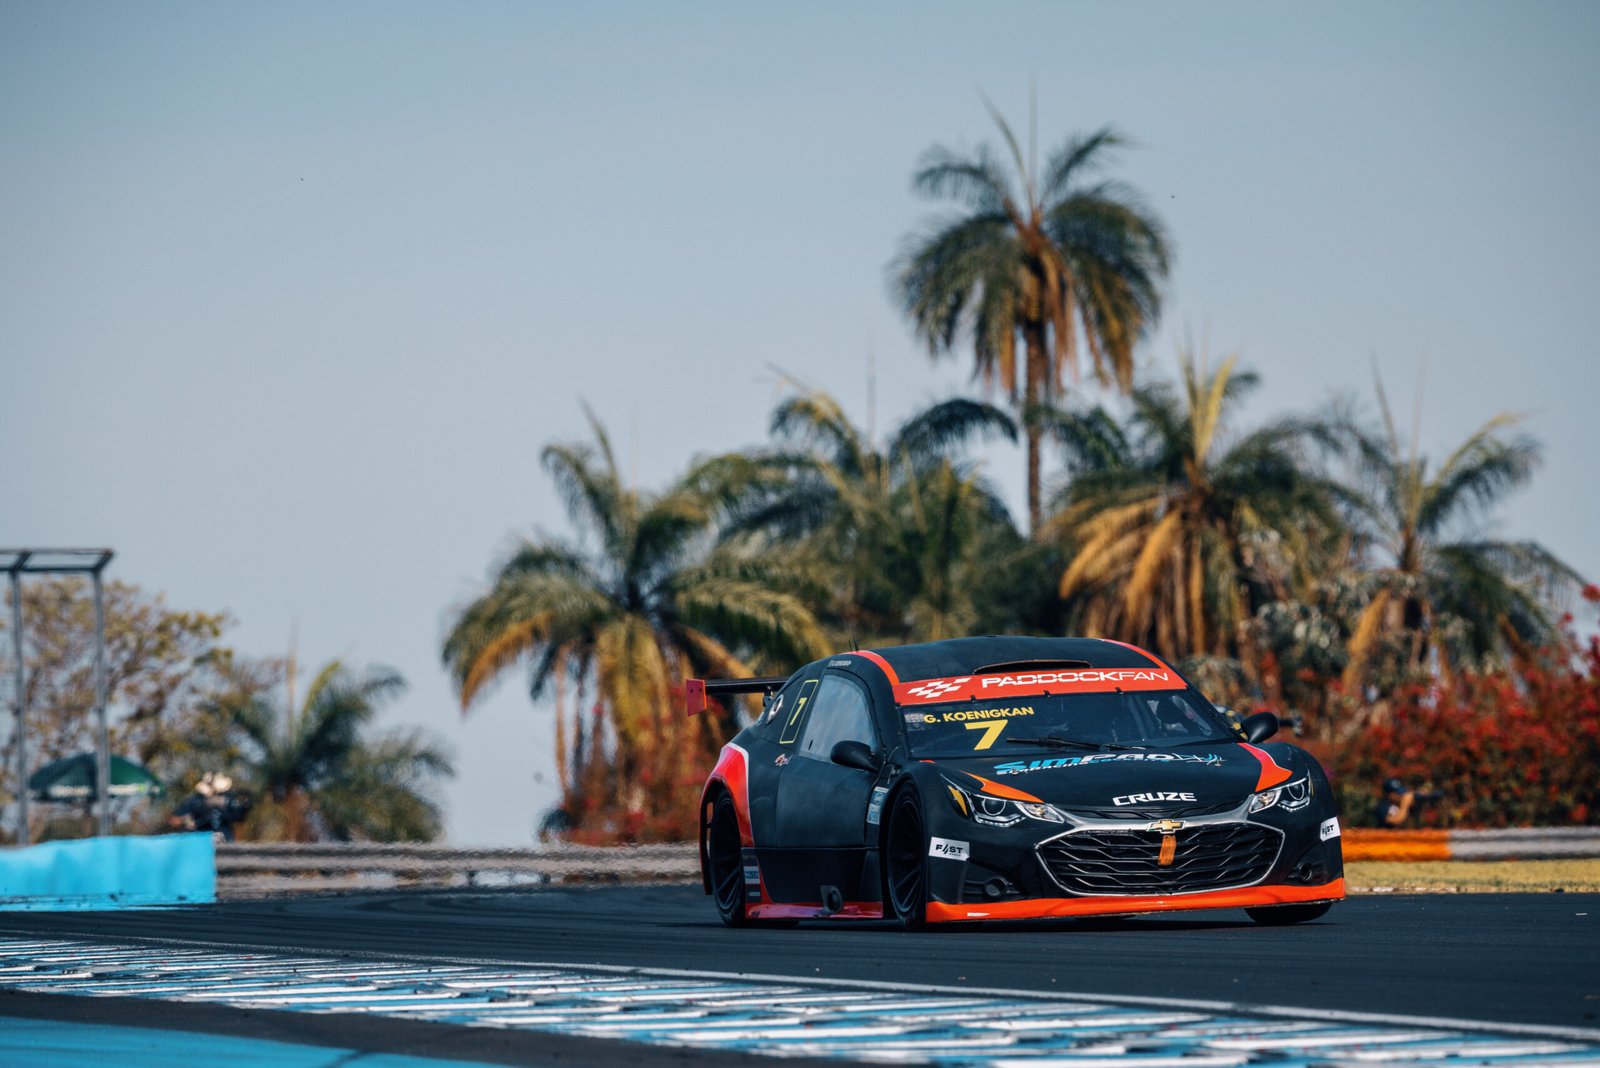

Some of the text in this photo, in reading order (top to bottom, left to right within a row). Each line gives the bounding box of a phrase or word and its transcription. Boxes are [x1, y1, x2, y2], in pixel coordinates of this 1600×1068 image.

[982, 671, 1168, 688] PADDOCKFAN
[923, 714, 941, 724] G.
[942, 706, 1035, 722] KOENIGKAN
[964, 719, 1008, 751] 7
[1112, 791, 1198, 807] CRUZE
